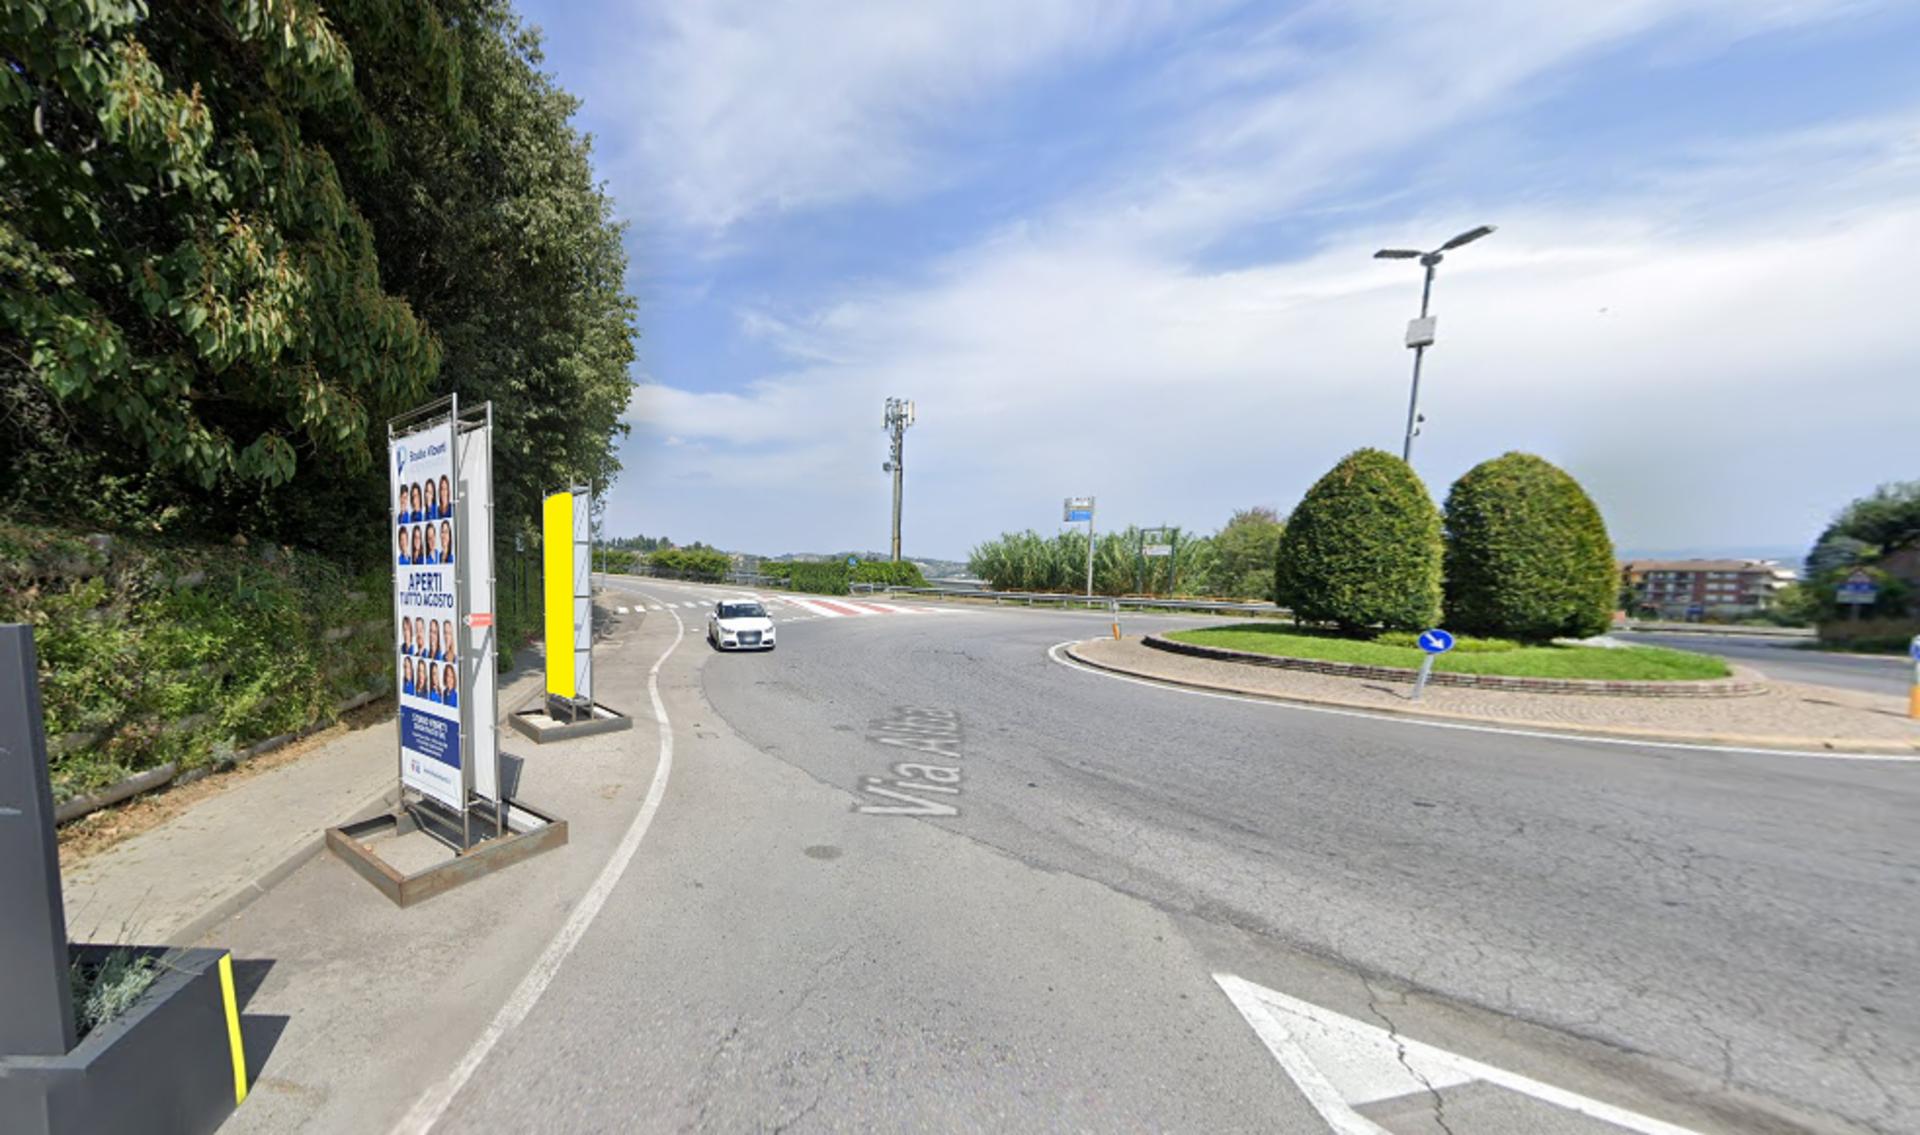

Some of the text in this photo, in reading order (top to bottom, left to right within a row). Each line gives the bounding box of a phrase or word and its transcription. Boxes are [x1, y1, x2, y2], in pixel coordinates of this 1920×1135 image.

[408, 572, 442, 592] APERTI
[400, 592, 453, 608] TUTTO AGOSTO
